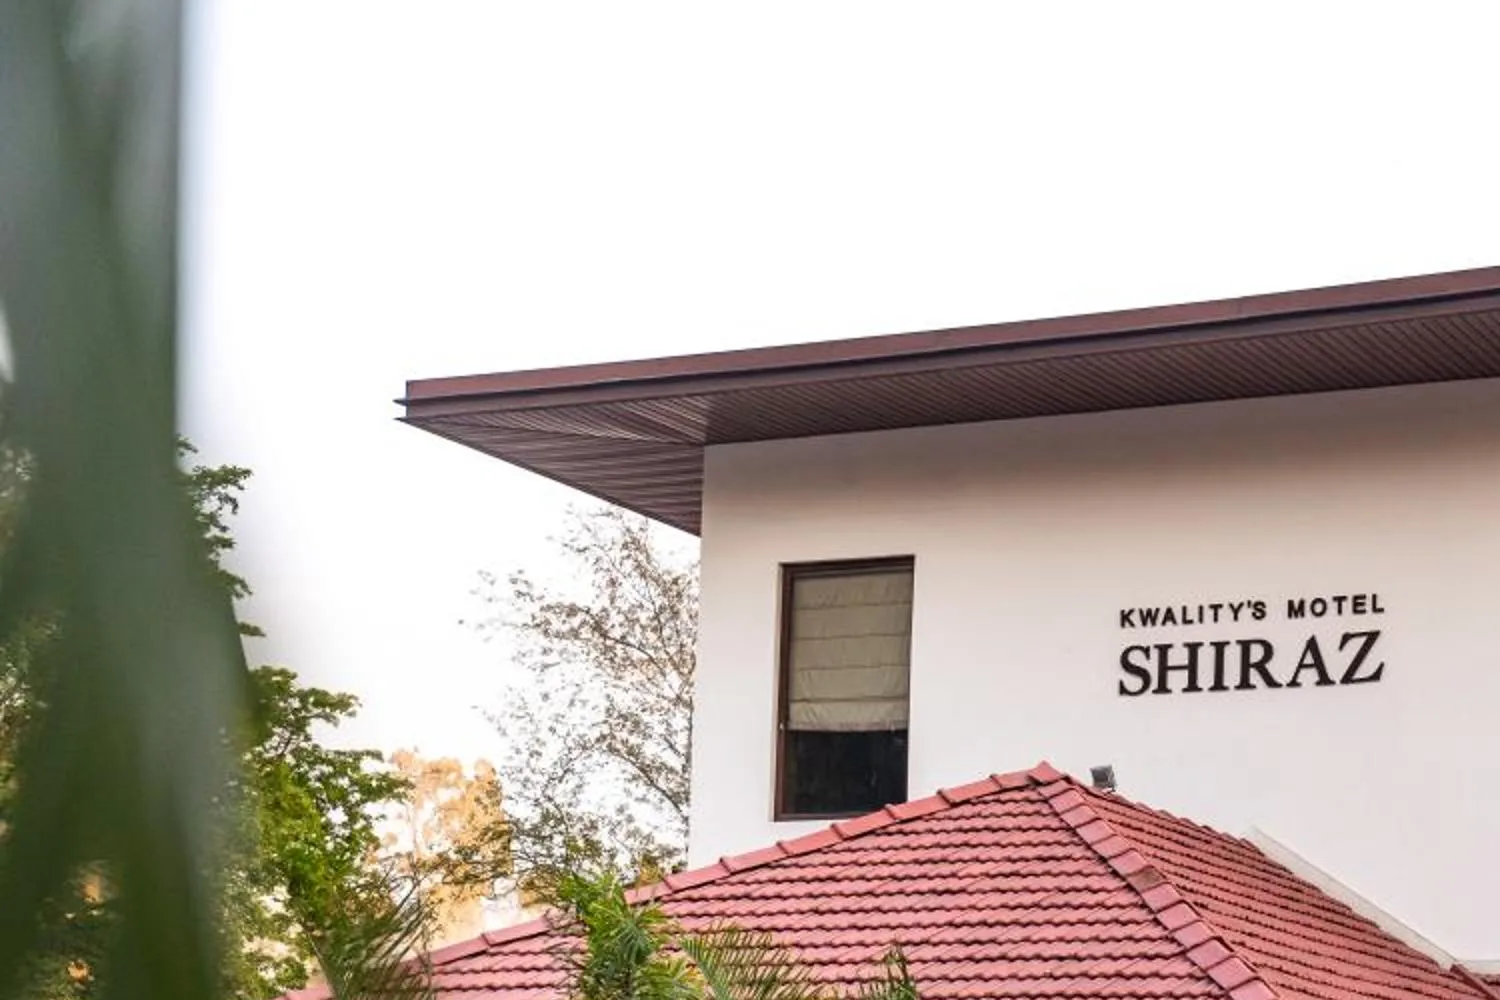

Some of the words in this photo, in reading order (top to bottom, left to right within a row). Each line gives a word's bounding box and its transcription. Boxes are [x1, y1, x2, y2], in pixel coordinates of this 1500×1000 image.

[1119, 599, 1267, 629] KWALITY'S
[1287, 593, 1385, 620] MOTEL
[1118, 629, 1385, 697] SHIRAZ
